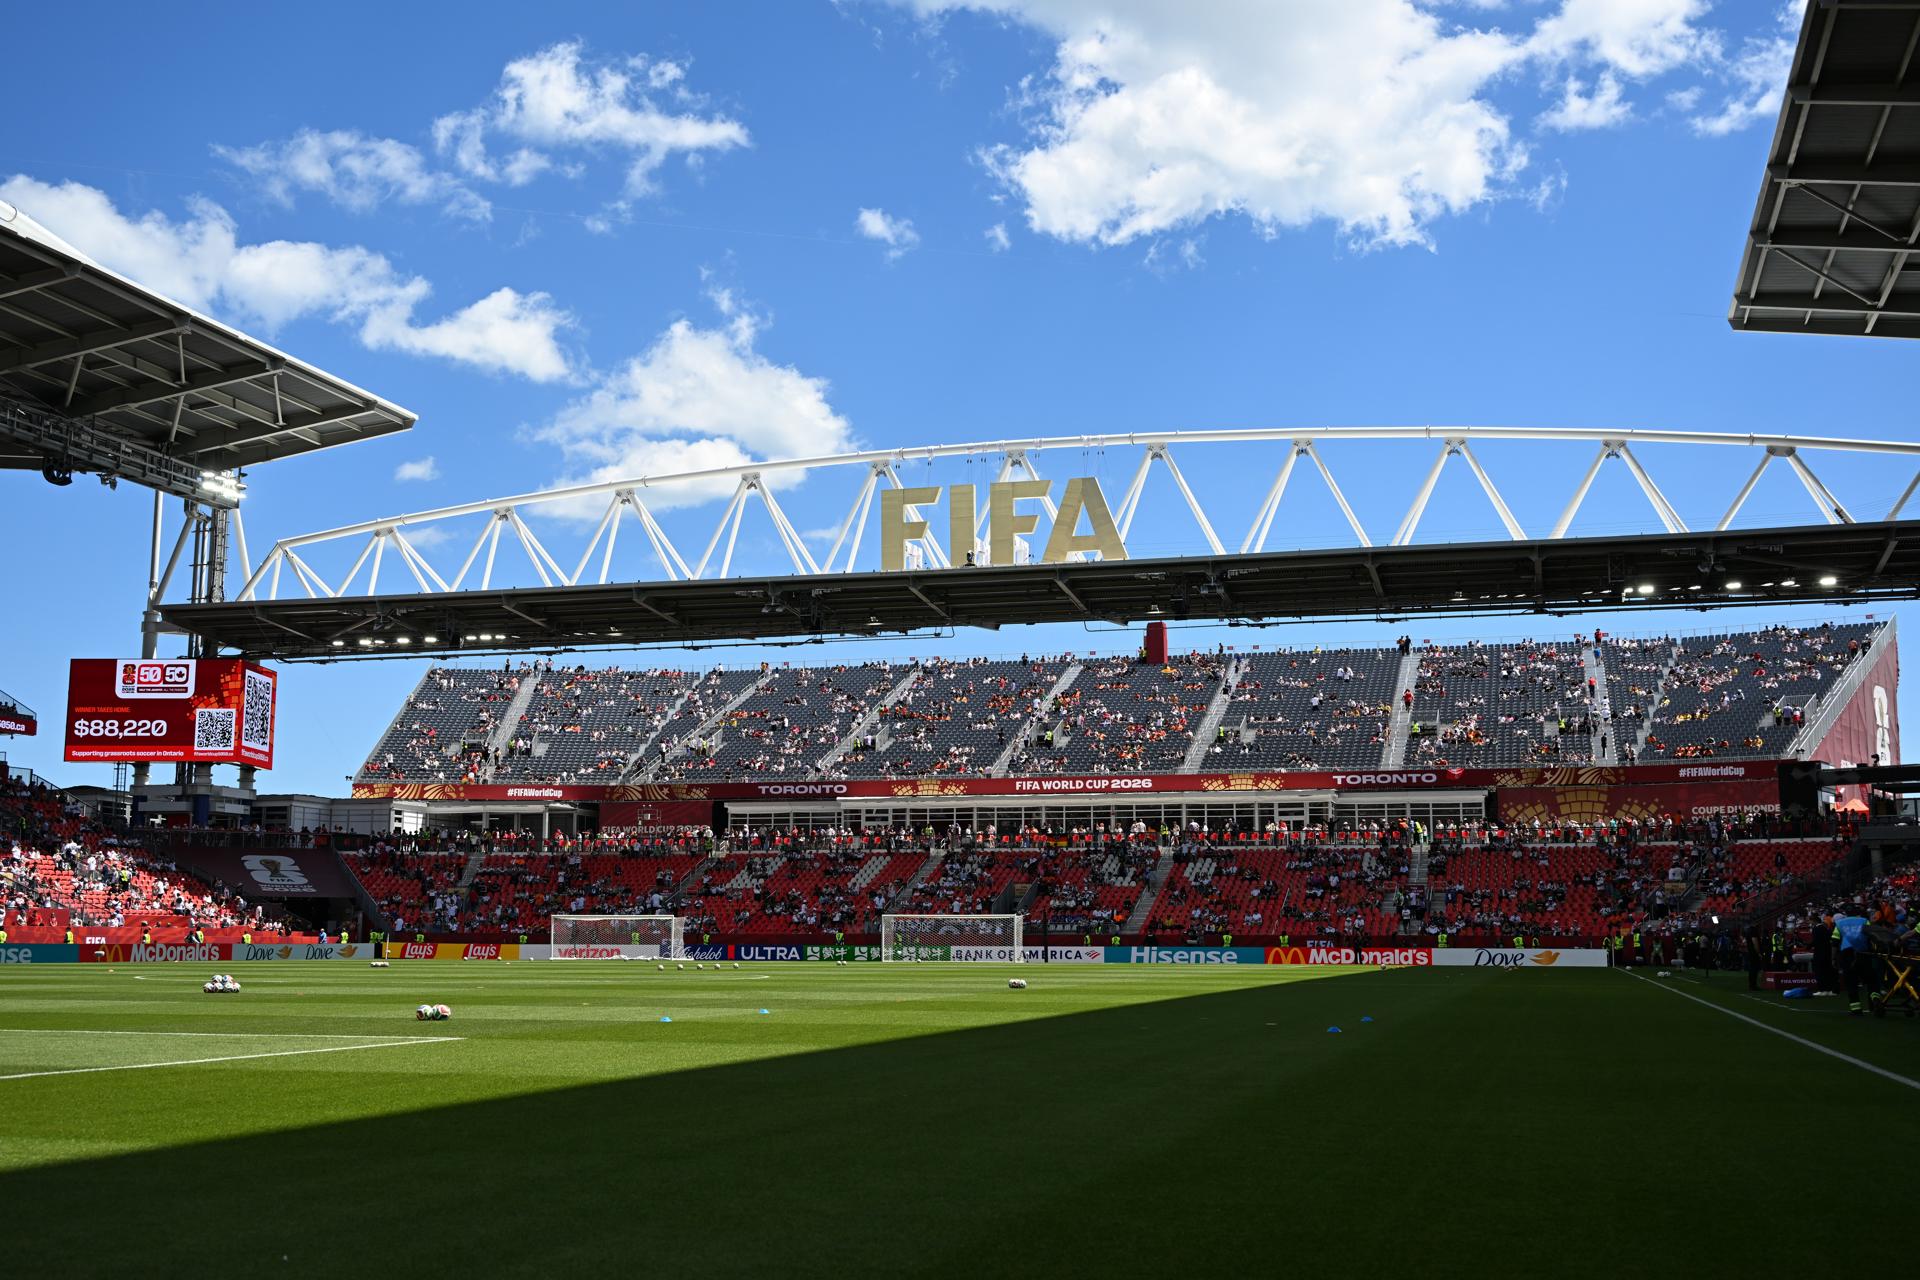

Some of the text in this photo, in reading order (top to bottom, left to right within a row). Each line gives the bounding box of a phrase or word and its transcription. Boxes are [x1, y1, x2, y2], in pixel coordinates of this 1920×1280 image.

[881, 477, 1129, 571] FIFA
[139, 666, 187, 682] 50 50
[0, 720, 25, 731] 050.ca
[74, 718, 167, 739] $88,220
[1679, 766, 1745, 777] #FIFAWorldCup
[1015, 778, 1152, 790] FIFA WORLD CUP 2026
[1332, 773, 1437, 785] TORONTO
[507, 788, 563, 798] #FIFAWorldCup
[758, 784, 847, 794] TORONTO
[1691, 806, 1726, 815] COUPE
[1744, 803, 1781, 814] MONDE
[602, 826, 621, 834] FIFA
[623, 825, 655, 834] WORLD
[656, 825, 675, 833] CUP
[85, 936, 106, 944] FIFA
[1306, 940, 1334, 948] FIFA
[130, 944, 220, 962] McDonald's
[245, 944, 275, 960] Dove
[305, 944, 334, 960] Dove
[404, 943, 433, 959] Lay's
[467, 944, 497, 960] Lay's
[558, 944, 621, 959] verizon
[740, 946, 800, 960] ULTRA
[822, 946, 848, 960] 蒙牛
[955, 950, 993, 961] BANK
[997, 950, 1015, 961] OF
[1131, 946, 1238, 964] Hisense
[1475, 949, 1524, 966] Dove
